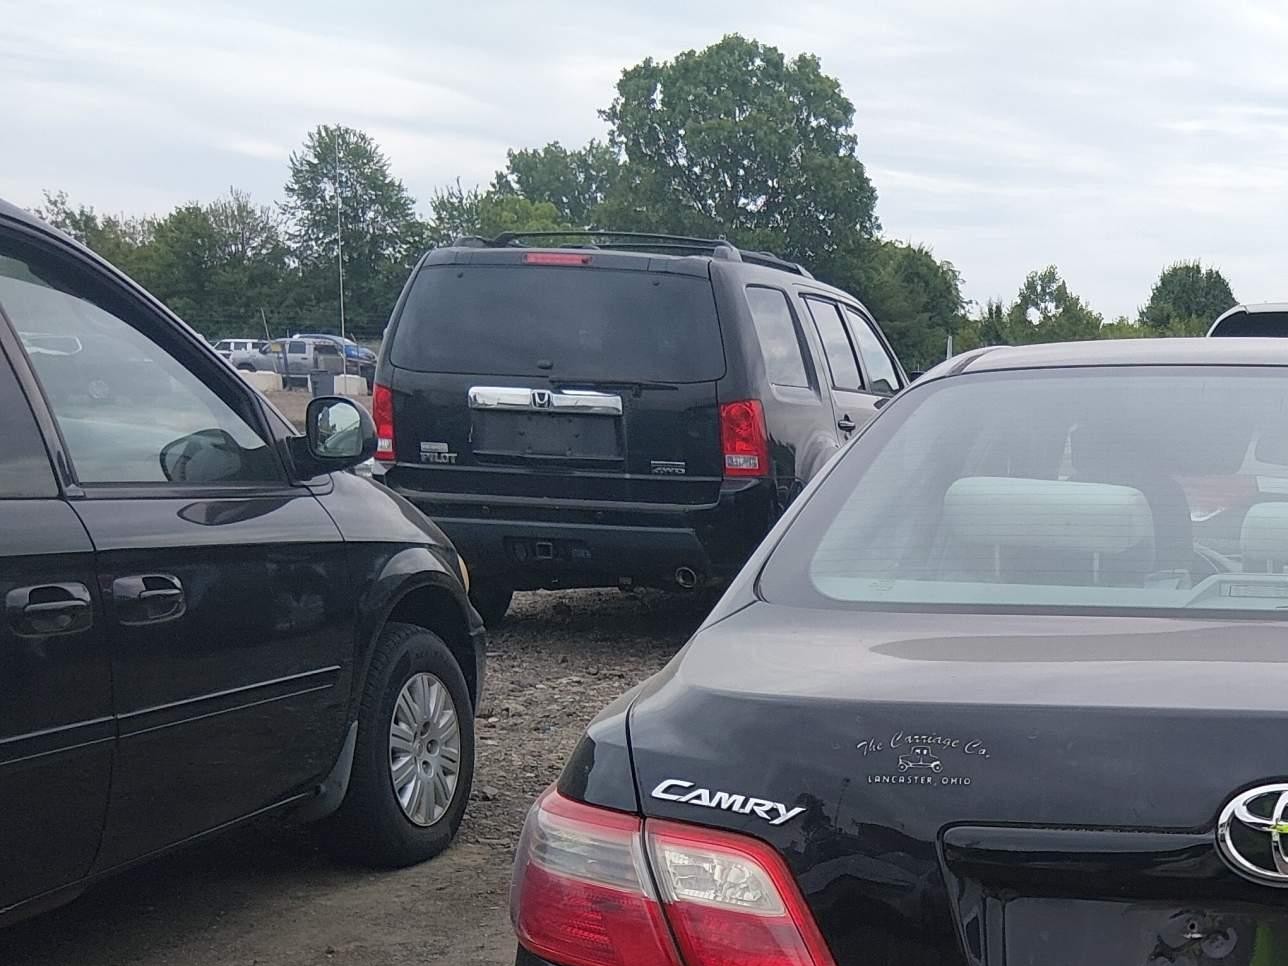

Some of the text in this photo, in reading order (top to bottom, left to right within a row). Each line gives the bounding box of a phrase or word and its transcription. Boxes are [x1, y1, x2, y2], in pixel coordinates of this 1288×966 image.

[420, 452, 457, 464] PILOT
[857, 730, 990, 758] The Carriage Co.
[868, 775, 971, 786] LANCASTER, OHIO
[651, 779, 807, 825] CAMRY
